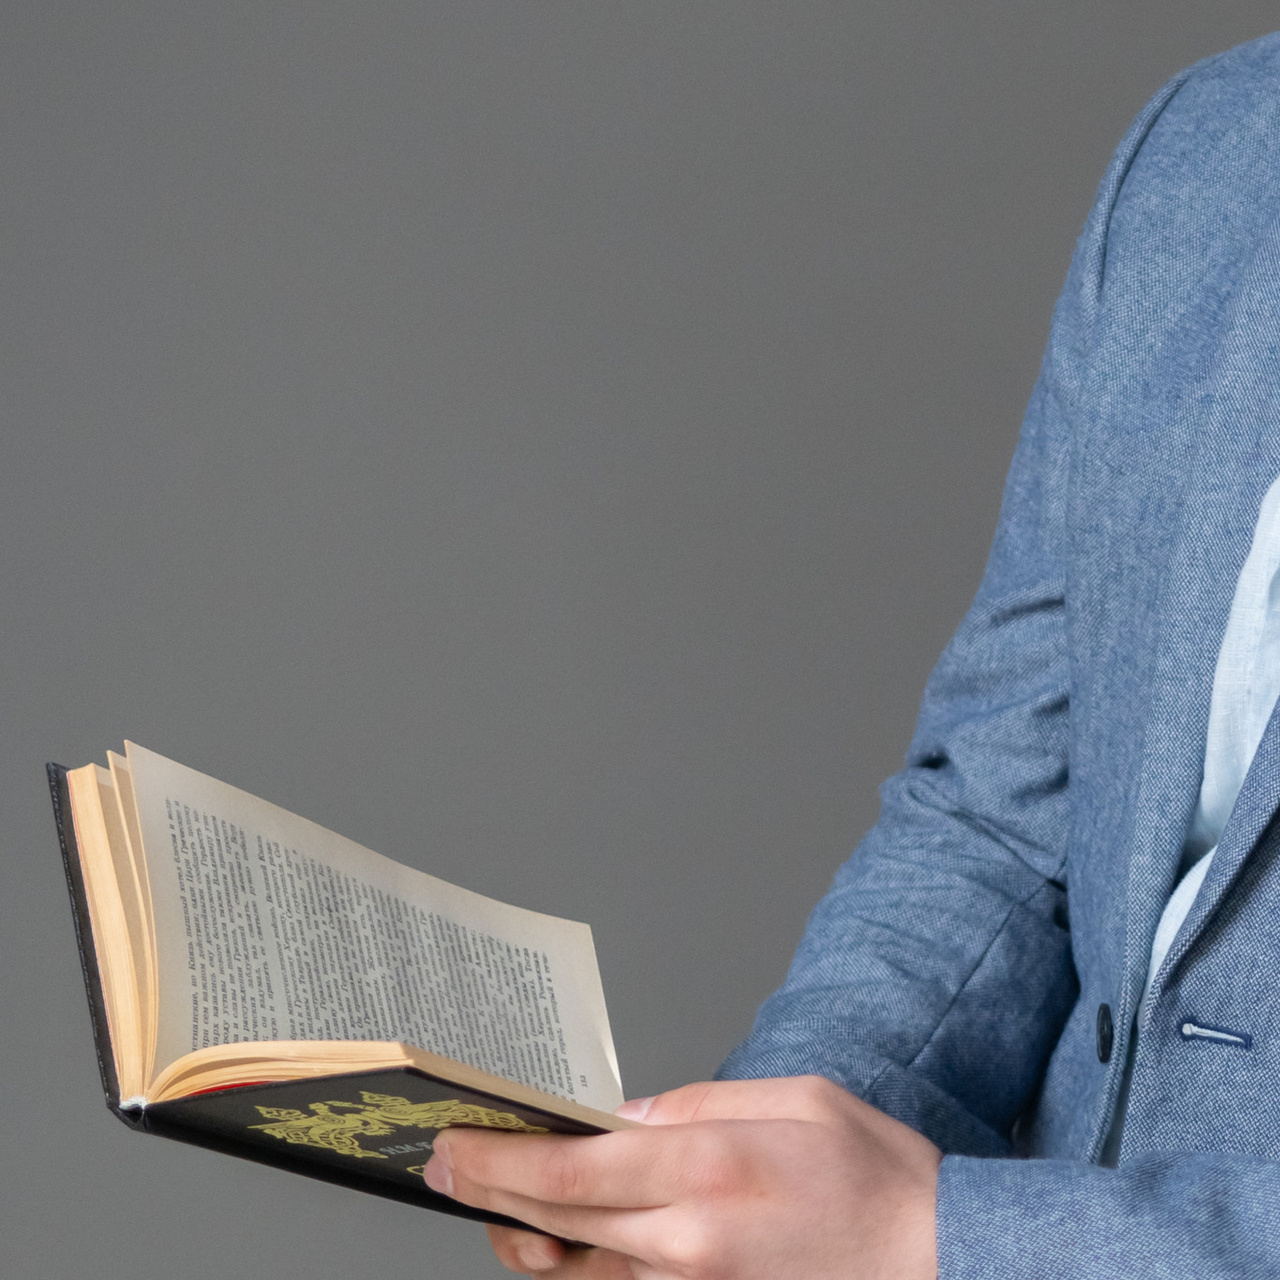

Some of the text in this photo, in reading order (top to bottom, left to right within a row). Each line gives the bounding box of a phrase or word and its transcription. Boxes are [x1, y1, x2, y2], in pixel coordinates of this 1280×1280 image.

[187, 940, 196, 970] Князь
[215, 943, 224, 975] нового
[199, 962, 208, 1002] важном
[210, 971, 219, 1017] казались
[220, 979, 229, 1015] уставы
[236, 966, 250, 1031] рассуждении
[230, 988, 238, 1018] славы
[261, 1015, 268, 1028] он
